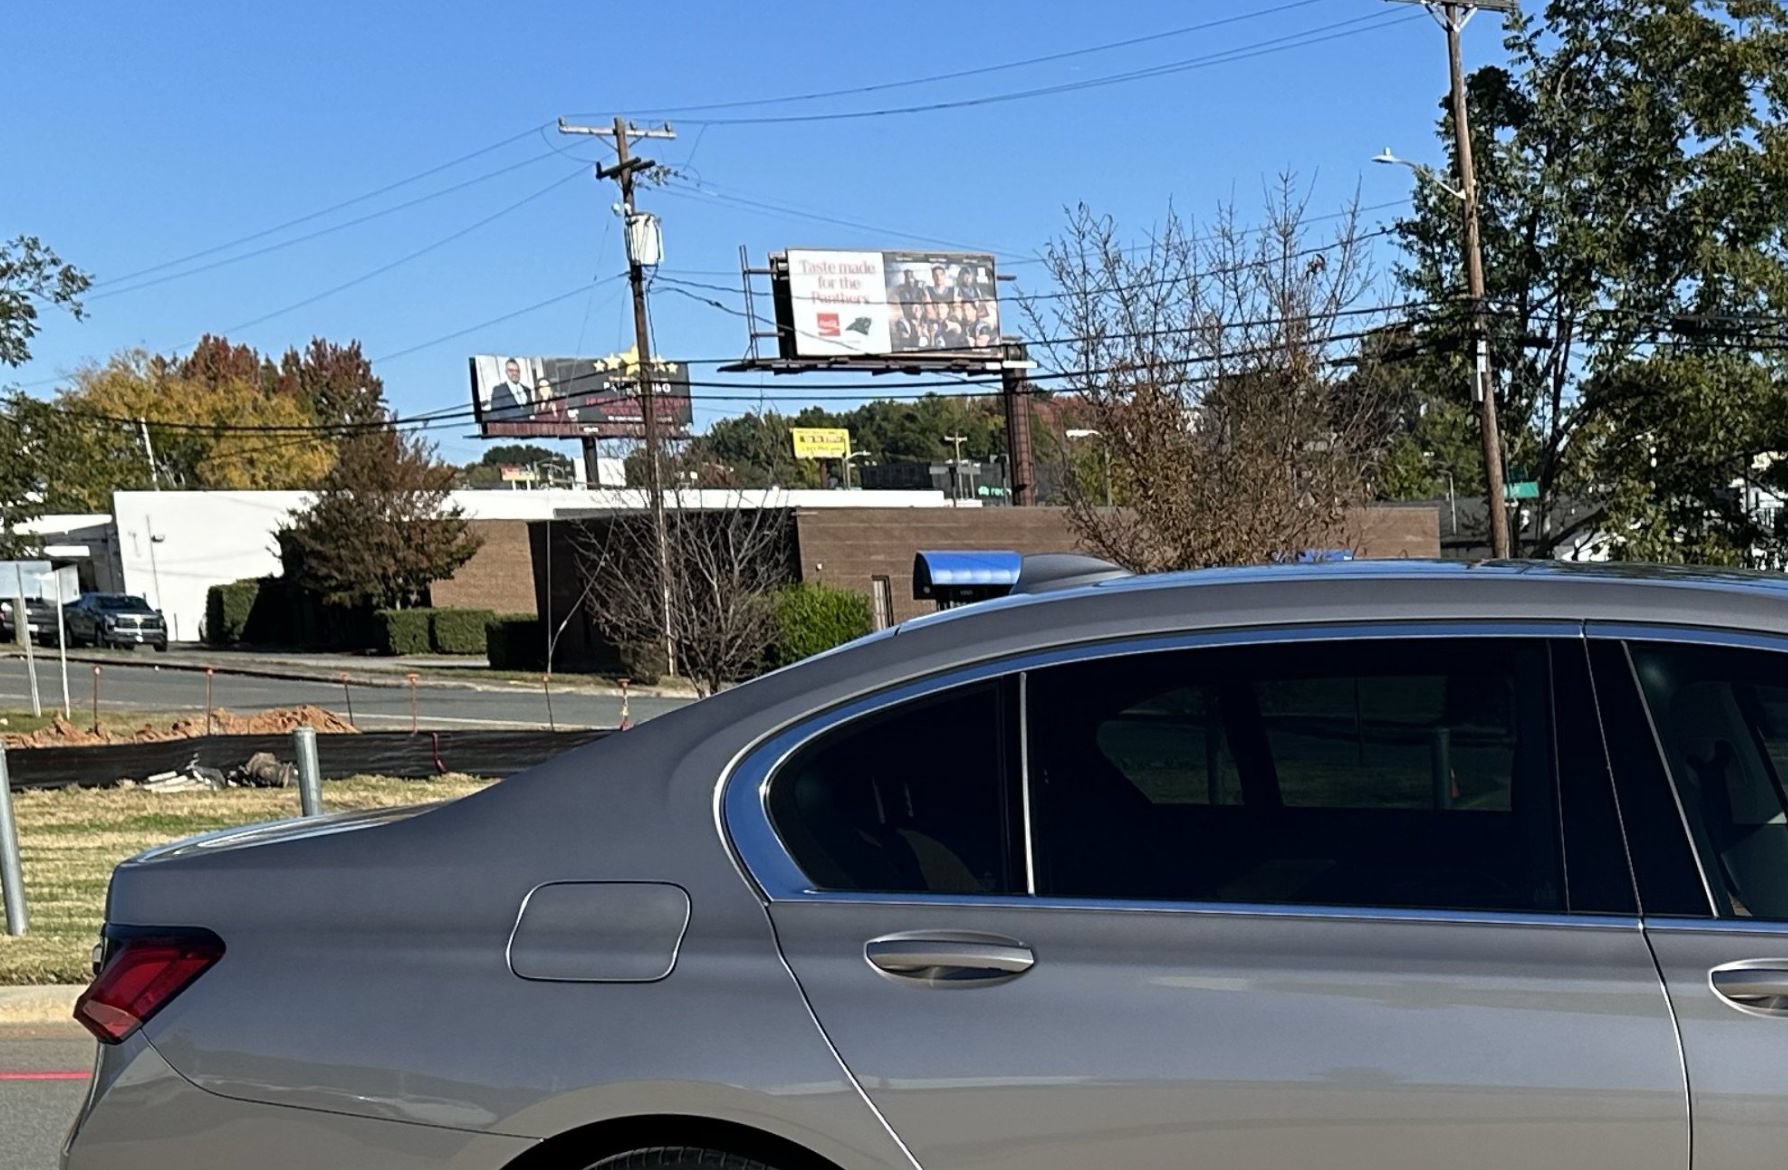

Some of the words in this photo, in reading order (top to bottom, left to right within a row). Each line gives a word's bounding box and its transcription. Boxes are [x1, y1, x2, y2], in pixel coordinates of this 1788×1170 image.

[800, 260, 836, 274] Taste
[839, 261, 875, 274] made
[818, 275, 836, 290] for
[840, 276, 862, 290] the
[811, 290, 870, 305] Panthers
